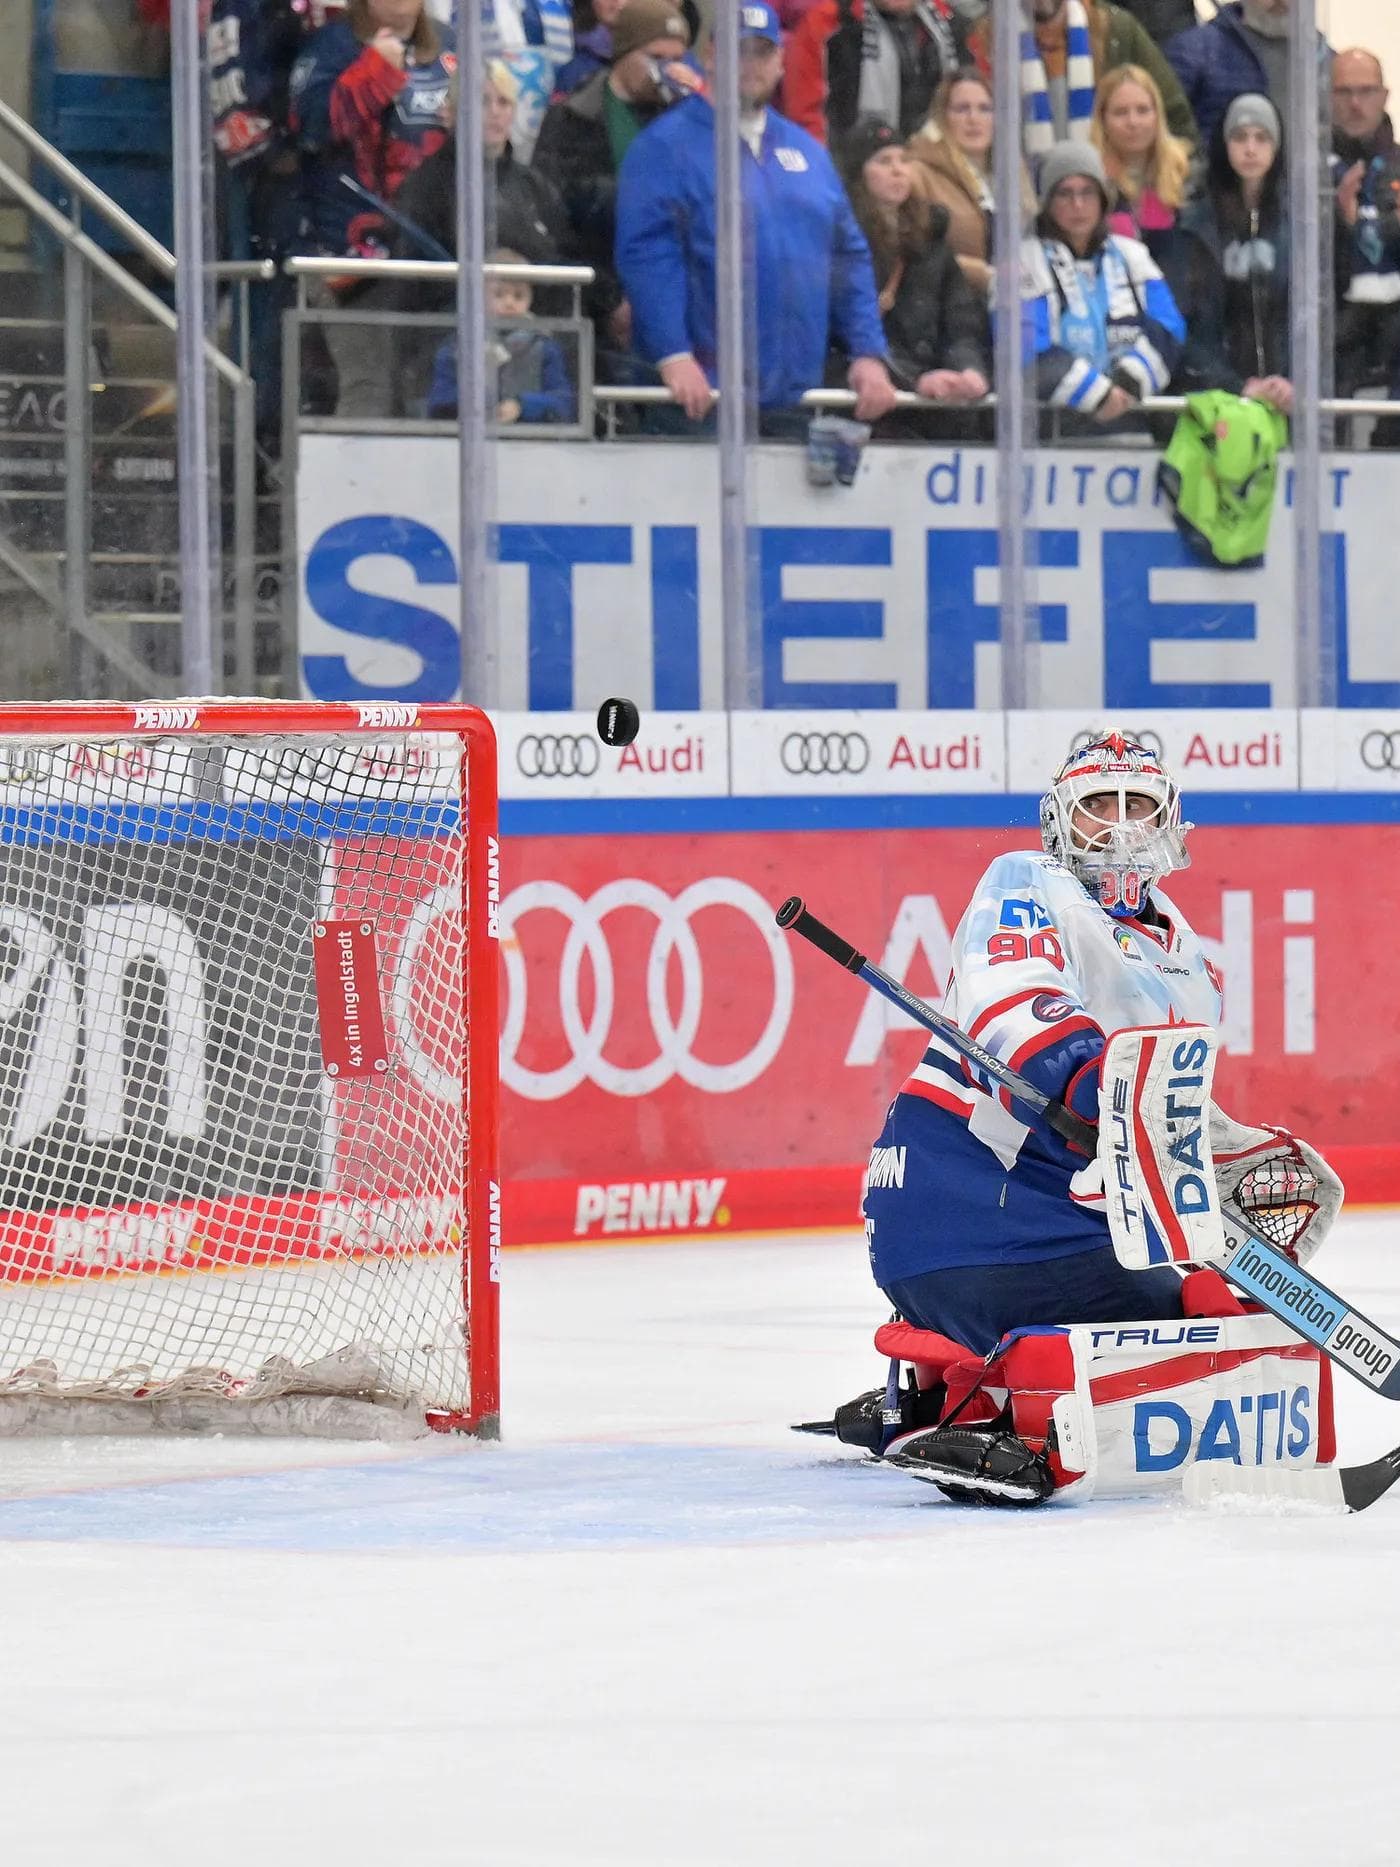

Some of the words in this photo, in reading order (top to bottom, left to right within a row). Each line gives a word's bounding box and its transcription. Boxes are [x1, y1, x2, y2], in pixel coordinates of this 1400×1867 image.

[616, 736, 705, 774] Audi
[889, 734, 981, 770] Audi
[1183, 732, 1283, 768] Audi
[986, 931, 1066, 973] 90
[337, 929, 360, 1020] Ingolstadt
[344, 1023, 361, 1041] in
[348, 1043, 363, 1067] 4x
[968, 1044, 1008, 1076] MACH
[1164, 1036, 1211, 1215] DATIS
[1112, 1076, 1139, 1233] TRUE
[1236, 1244, 1336, 1333] innovation
[1331, 1324, 1392, 1377] group
[1090, 1325, 1220, 1349] TRUE
[1133, 1384, 1311, 1473] DATIS
